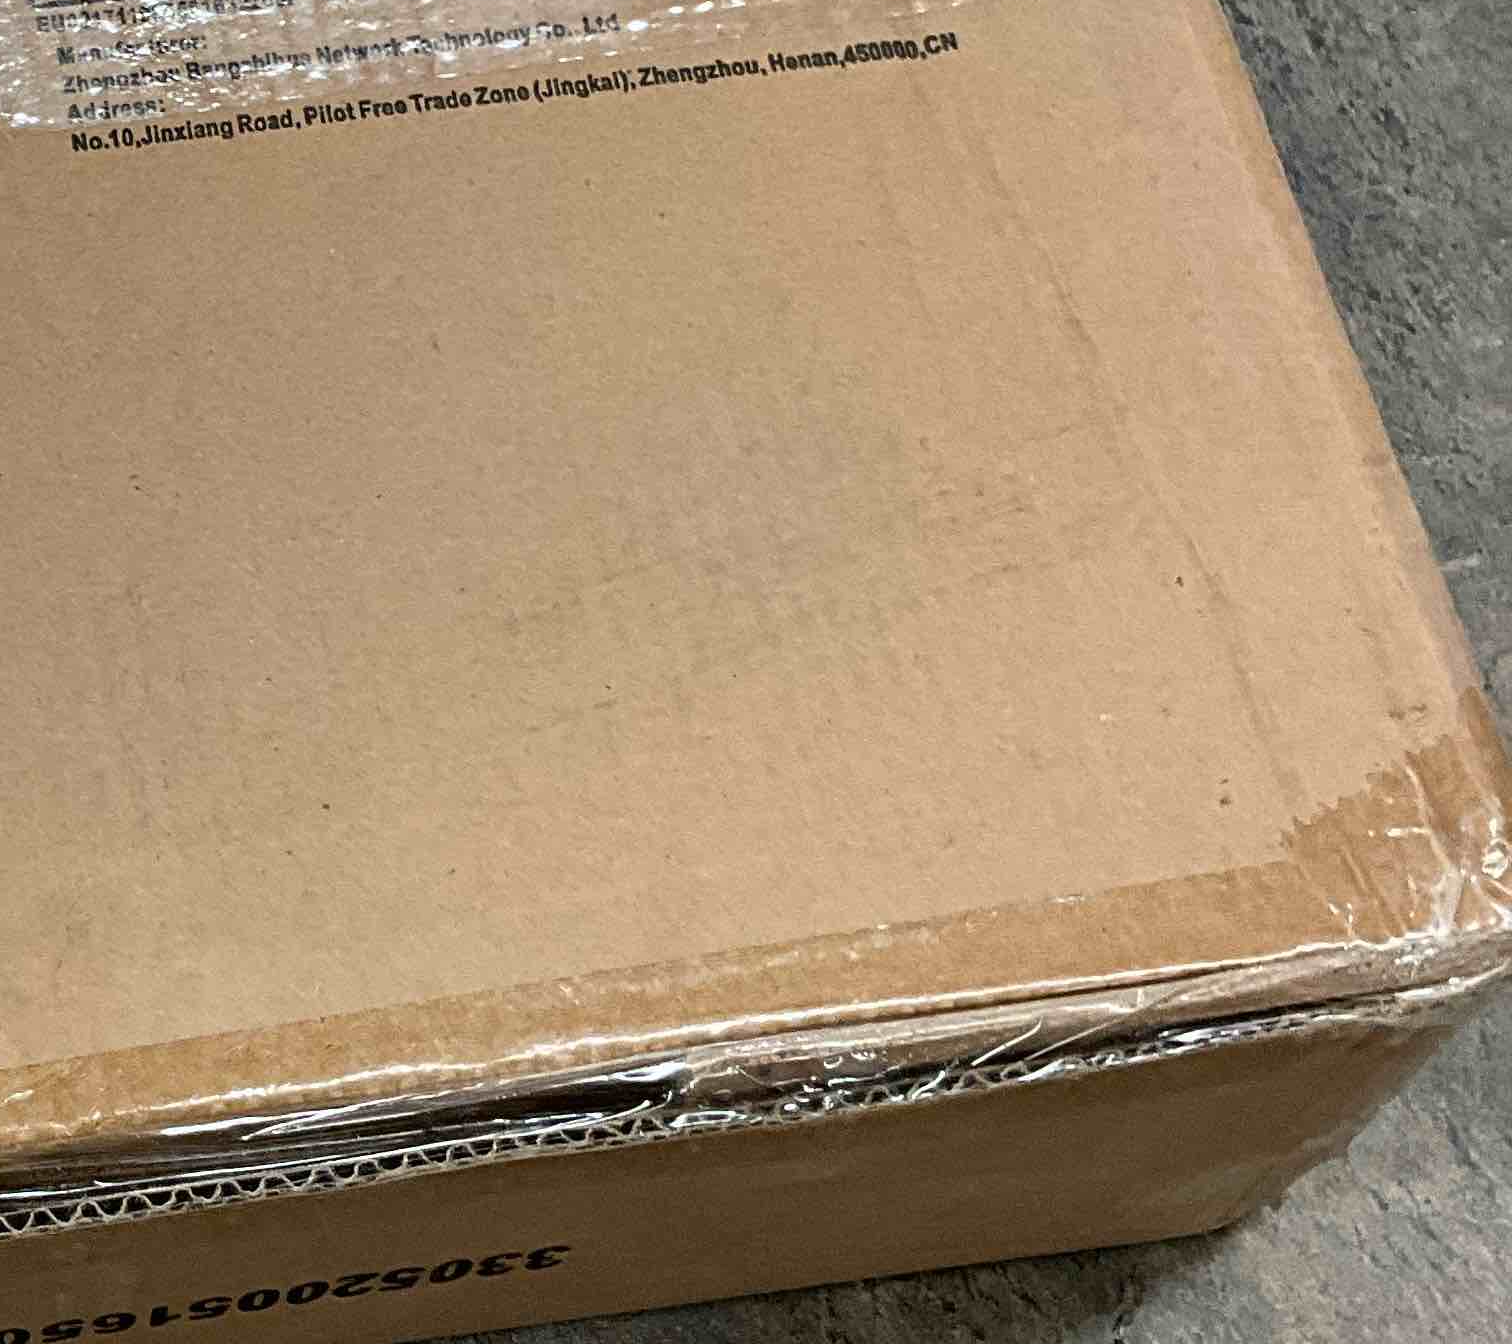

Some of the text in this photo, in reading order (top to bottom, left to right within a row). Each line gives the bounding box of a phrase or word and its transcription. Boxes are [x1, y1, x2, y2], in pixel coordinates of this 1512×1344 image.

[316, 36, 402, 66] Network
[67, 98, 166, 121] Address:
[71, 118, 233, 152] No.10,Jinxiang
[236, 107, 301, 135] Road,
[304, 101, 357, 127] Pilot
[360, 98, 408, 120] Free
[409, 88, 473, 112] Trade
[473, 82, 530, 106] Zone
[639, 54, 768, 87] Zhengzhou,
